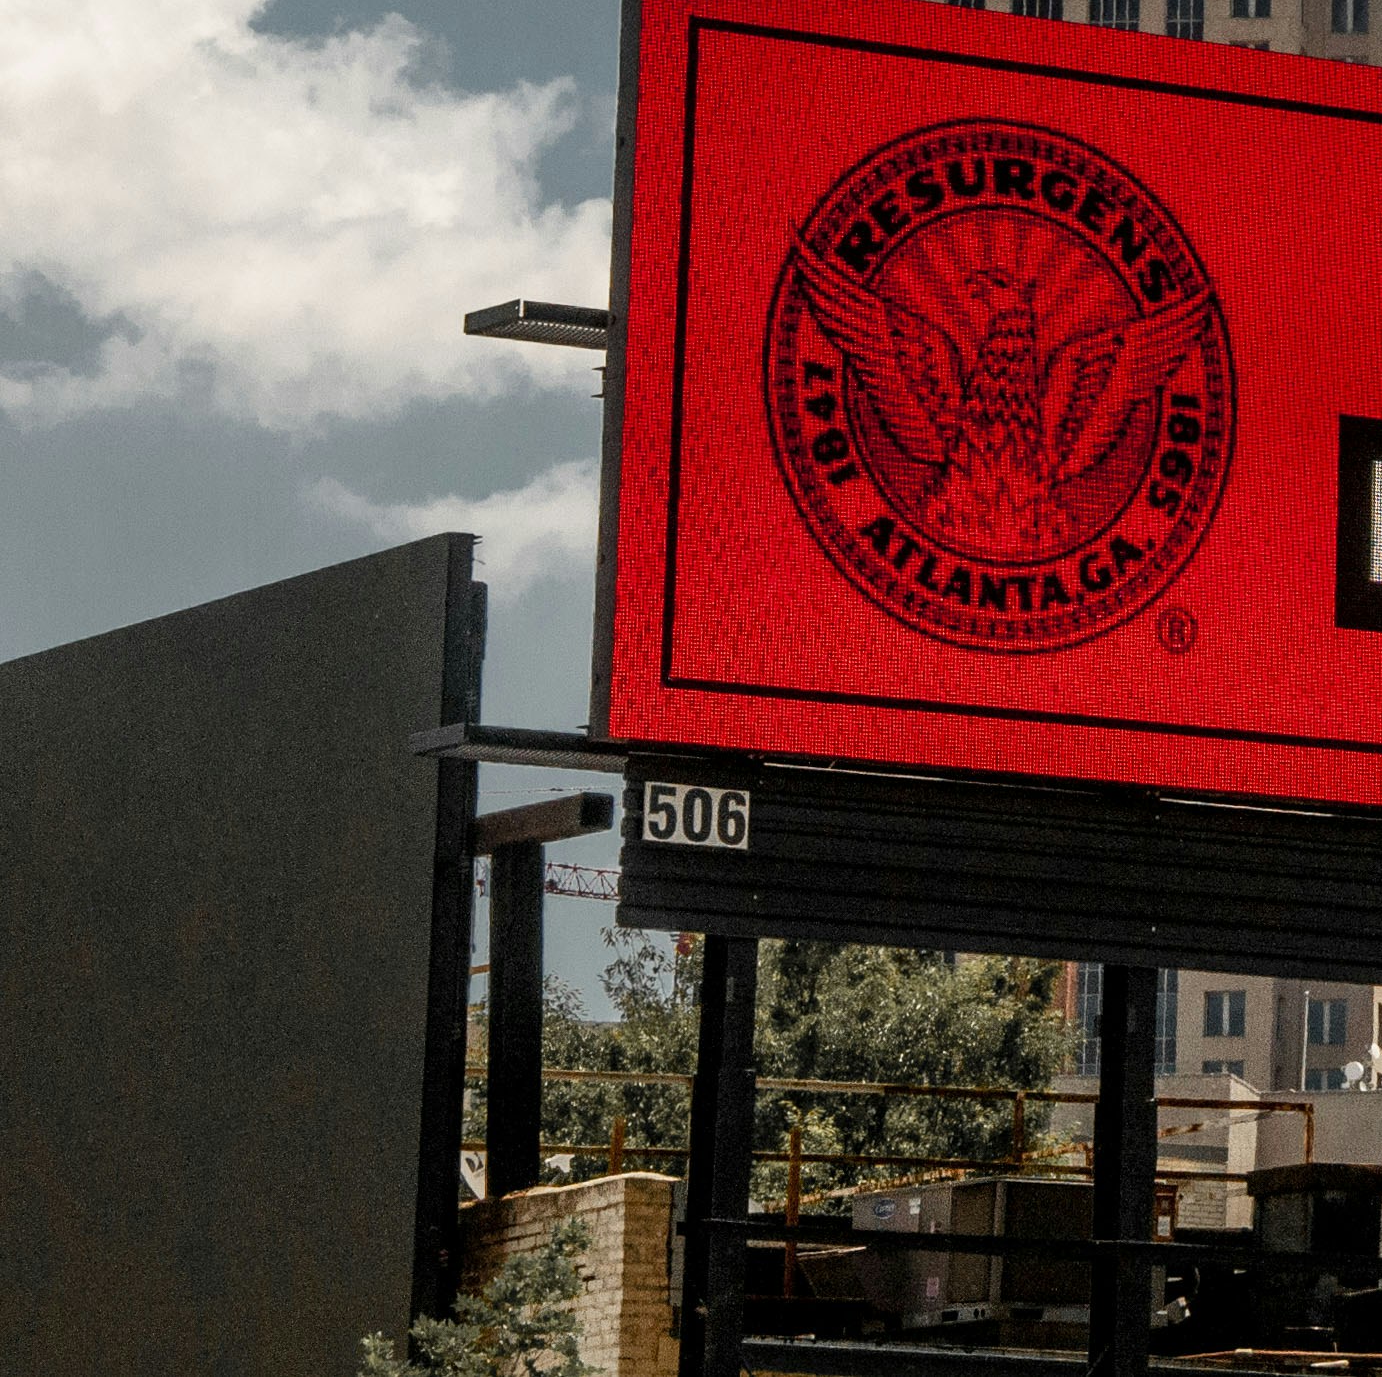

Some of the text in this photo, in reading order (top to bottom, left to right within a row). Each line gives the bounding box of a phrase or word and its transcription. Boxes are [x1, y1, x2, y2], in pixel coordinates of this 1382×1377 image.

[835, 156, 1178, 303] RESURGENS
[804, 361, 859, 486] 1847
[1149, 394, 1201, 517] 1865
[648, 784, 747, 846] 506
